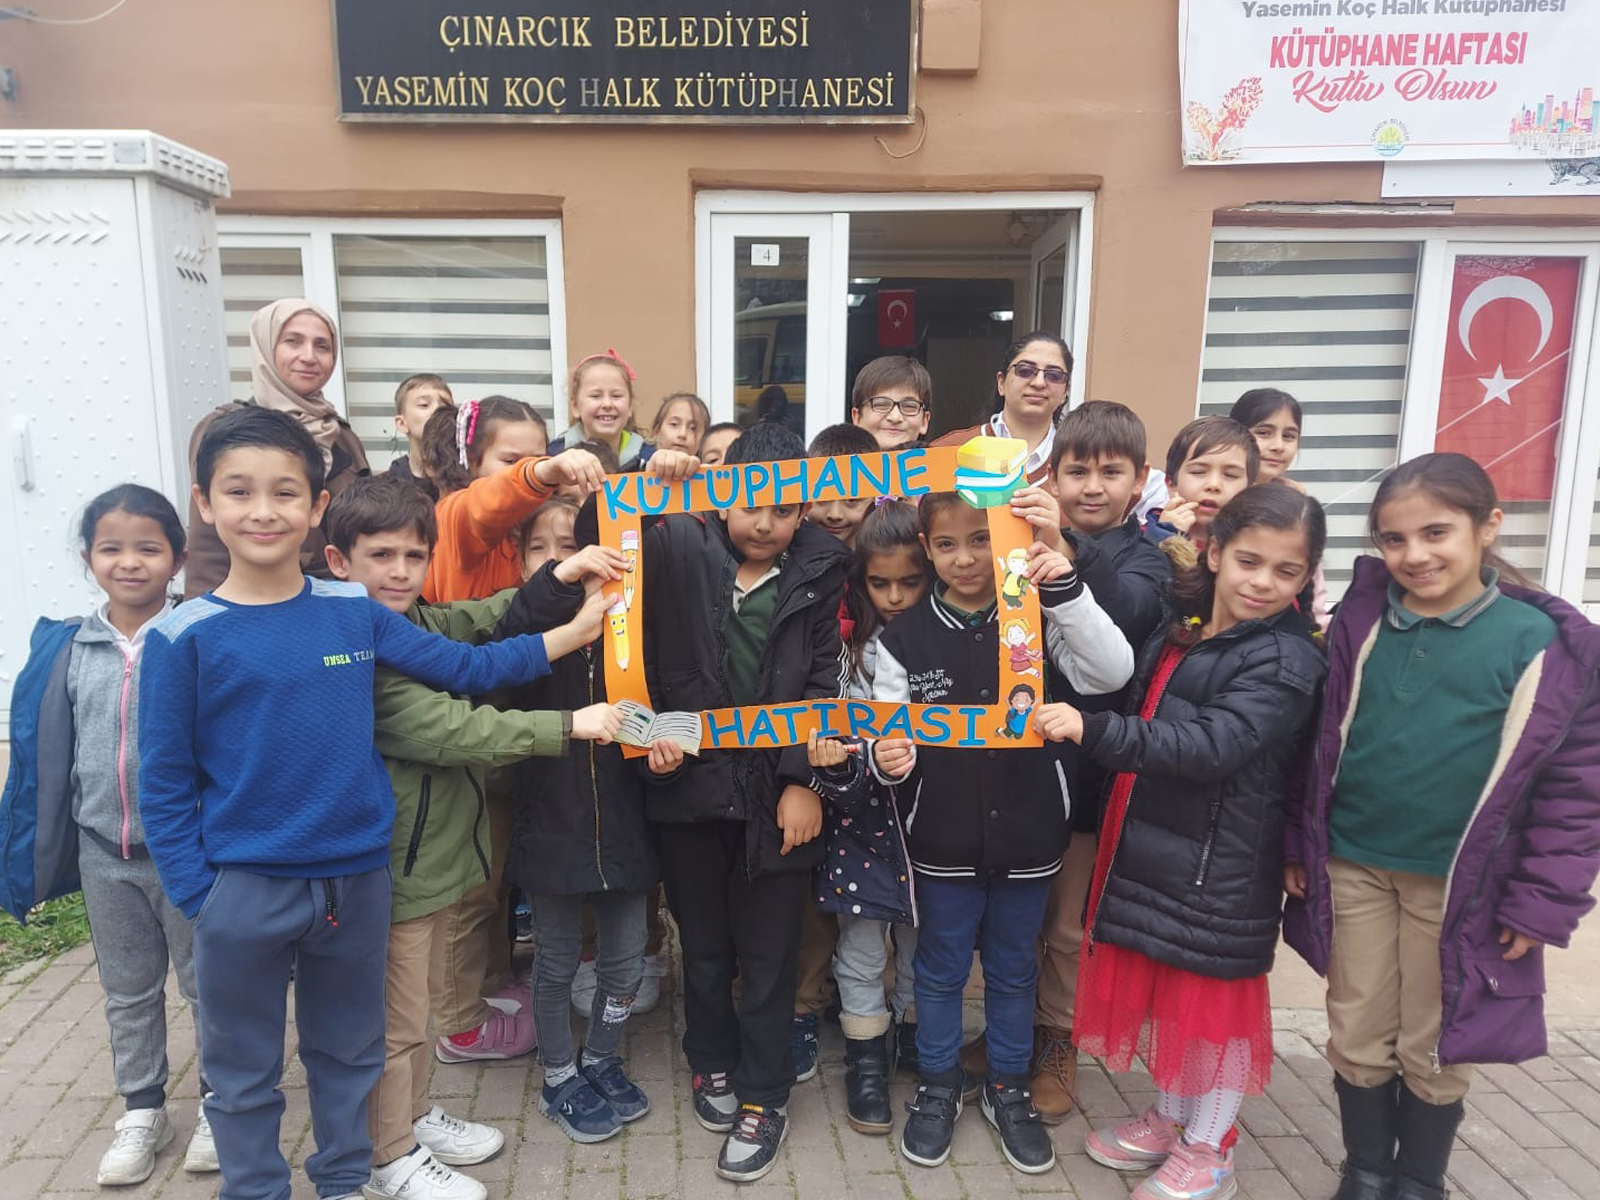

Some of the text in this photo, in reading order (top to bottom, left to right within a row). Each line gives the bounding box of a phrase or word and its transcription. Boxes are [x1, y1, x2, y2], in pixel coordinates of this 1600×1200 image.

[1242, 0, 1332, 18] Yasemin
[1337, 0, 1376, 18] Koç
[1382, 0, 1429, 15] Halk
[439, 10, 810, 53] ÇINARCIK BELEDİYESİ
[1270, 27, 1529, 68] KÜTÜPHANE HAFTASI
[354, 70, 895, 114] YASEMİN KOÇ HALK KÜTÜPHANESİ
[1292, 68, 1498, 113] Kutlu Olsun
[762, 248, 772, 262] 4
[603, 447, 931, 521] KÜTÜPHANE
[706, 702, 987, 748] HATIRASI
